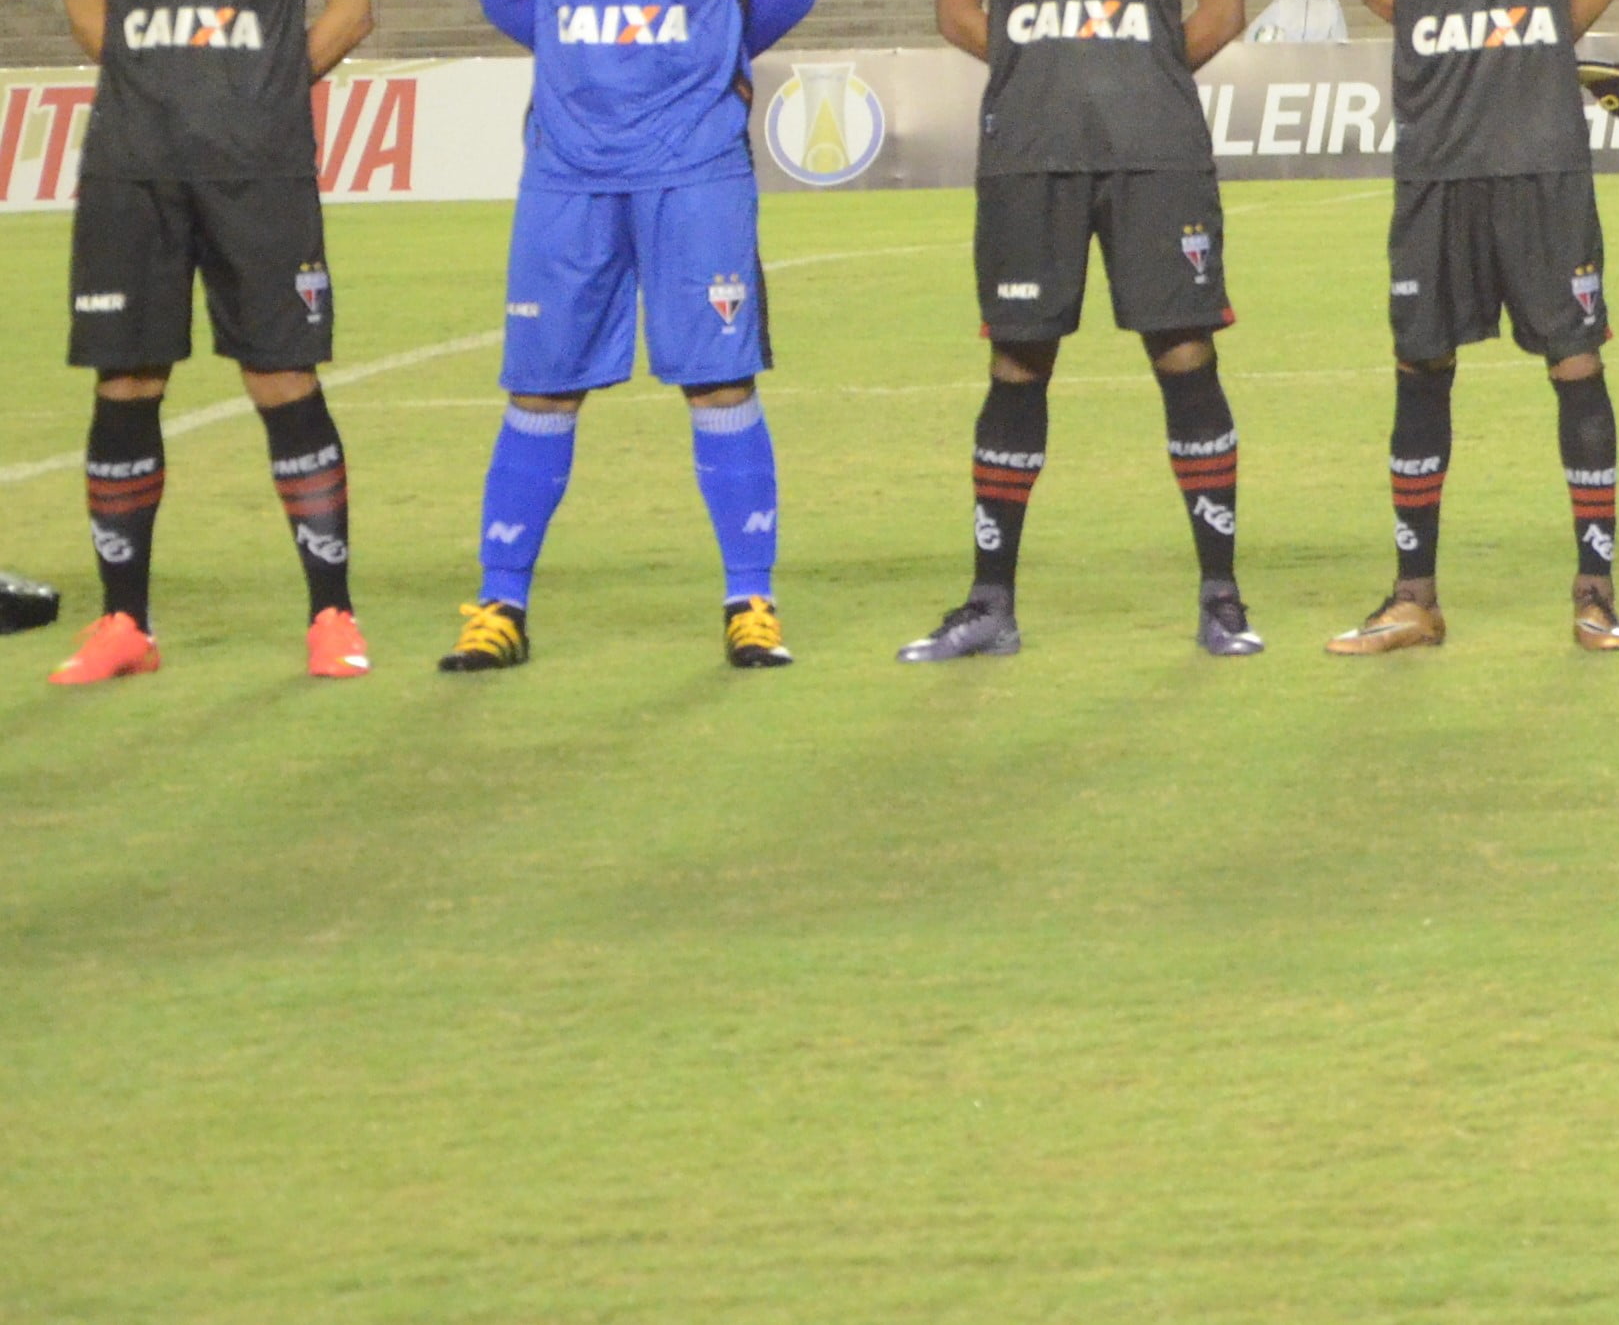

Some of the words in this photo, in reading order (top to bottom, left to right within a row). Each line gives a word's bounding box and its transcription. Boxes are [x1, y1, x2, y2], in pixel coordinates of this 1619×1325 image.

[123, 6, 263, 50] CAIXA
[1006, 0, 1150, 44] CAIXA
[1411, 6, 1558, 56] CAIXA
